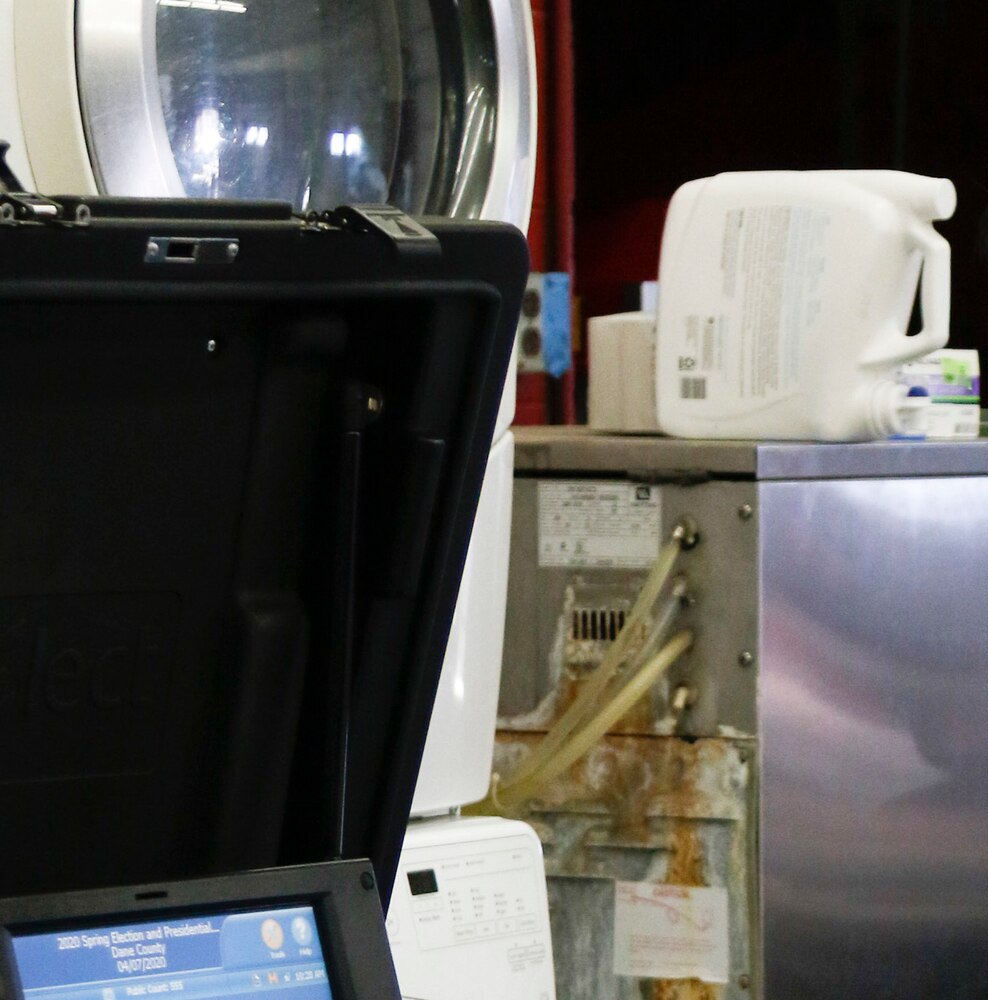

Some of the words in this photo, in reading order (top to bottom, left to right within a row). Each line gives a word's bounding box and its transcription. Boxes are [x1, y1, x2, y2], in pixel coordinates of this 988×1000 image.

[0, 619, 161, 714] lect
[57, 937, 80, 950] 2020
[82, 934, 110, 949] Spring
[110, 931, 144, 944] Election
[146, 927, 163, 939] and
[111, 946, 135, 959] Dane
[136, 943, 166, 956] County
[117, 956, 167, 973] 04/07/2020
[126, 985, 146, 997] Public
